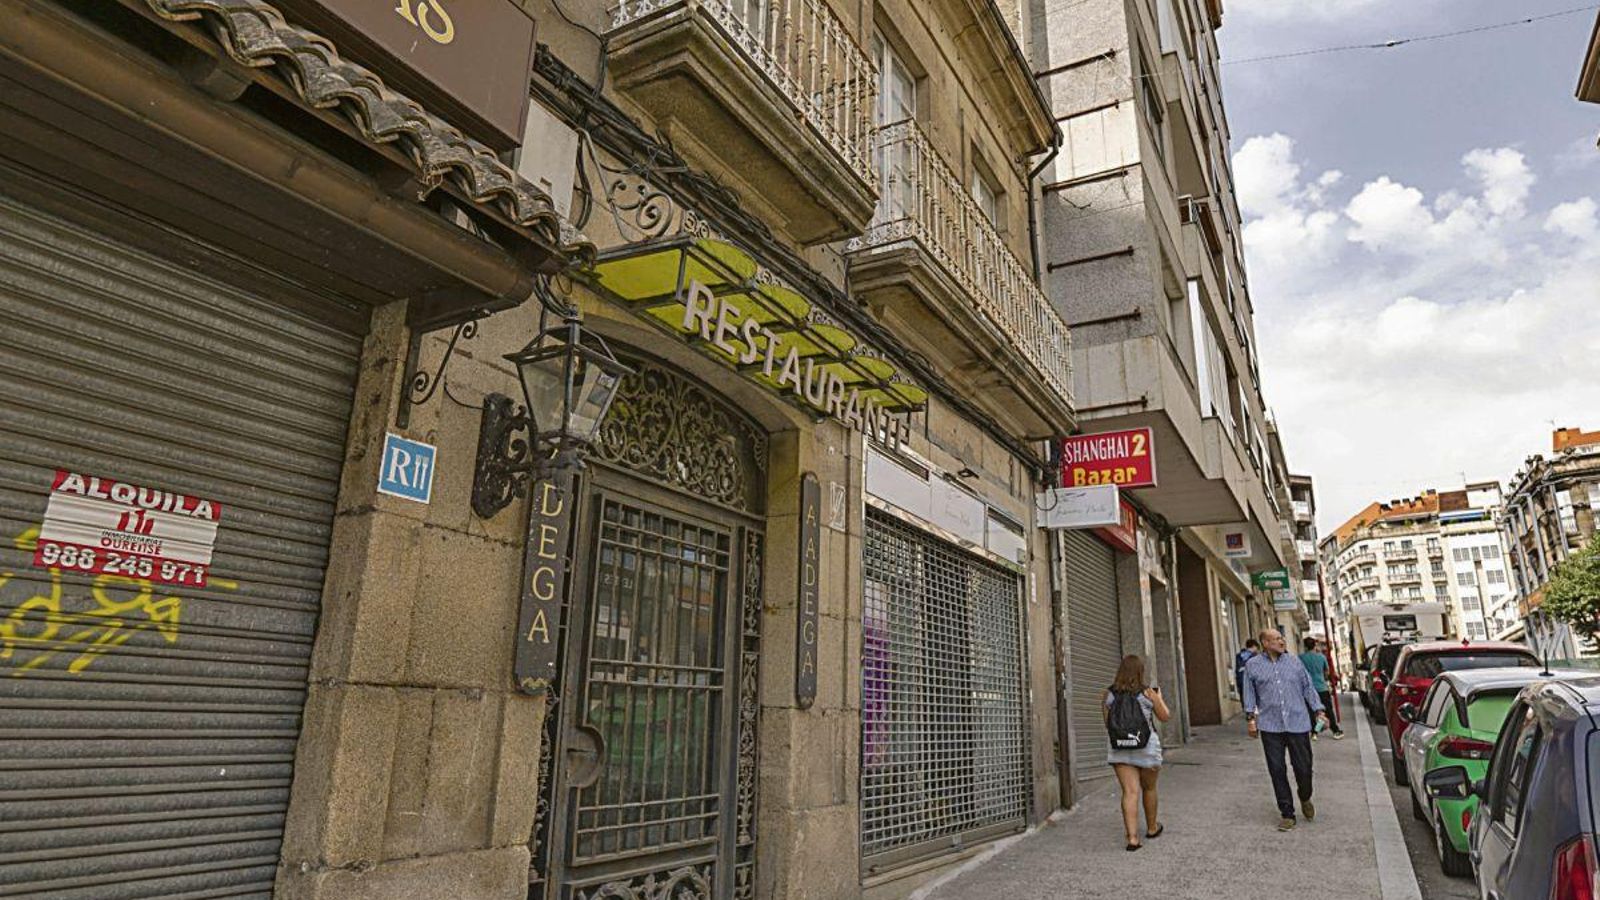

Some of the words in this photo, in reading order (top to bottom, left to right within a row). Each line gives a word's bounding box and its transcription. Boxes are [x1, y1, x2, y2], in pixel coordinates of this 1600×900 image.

[682, 278, 911, 449] RESTAURANTE
[1064, 435, 1129, 464] SHANGHAI
[1131, 433, 1146, 456] 2
[58, 473, 213, 520] ALQUILA
[1072, 465, 1137, 487] Bazar
[42, 543, 97, 570] 988
[102, 552, 153, 577] 245
[160, 560, 205, 584] 971
[100, 536, 162, 555] OURENSE
[526, 448, 563, 643] DEGA
